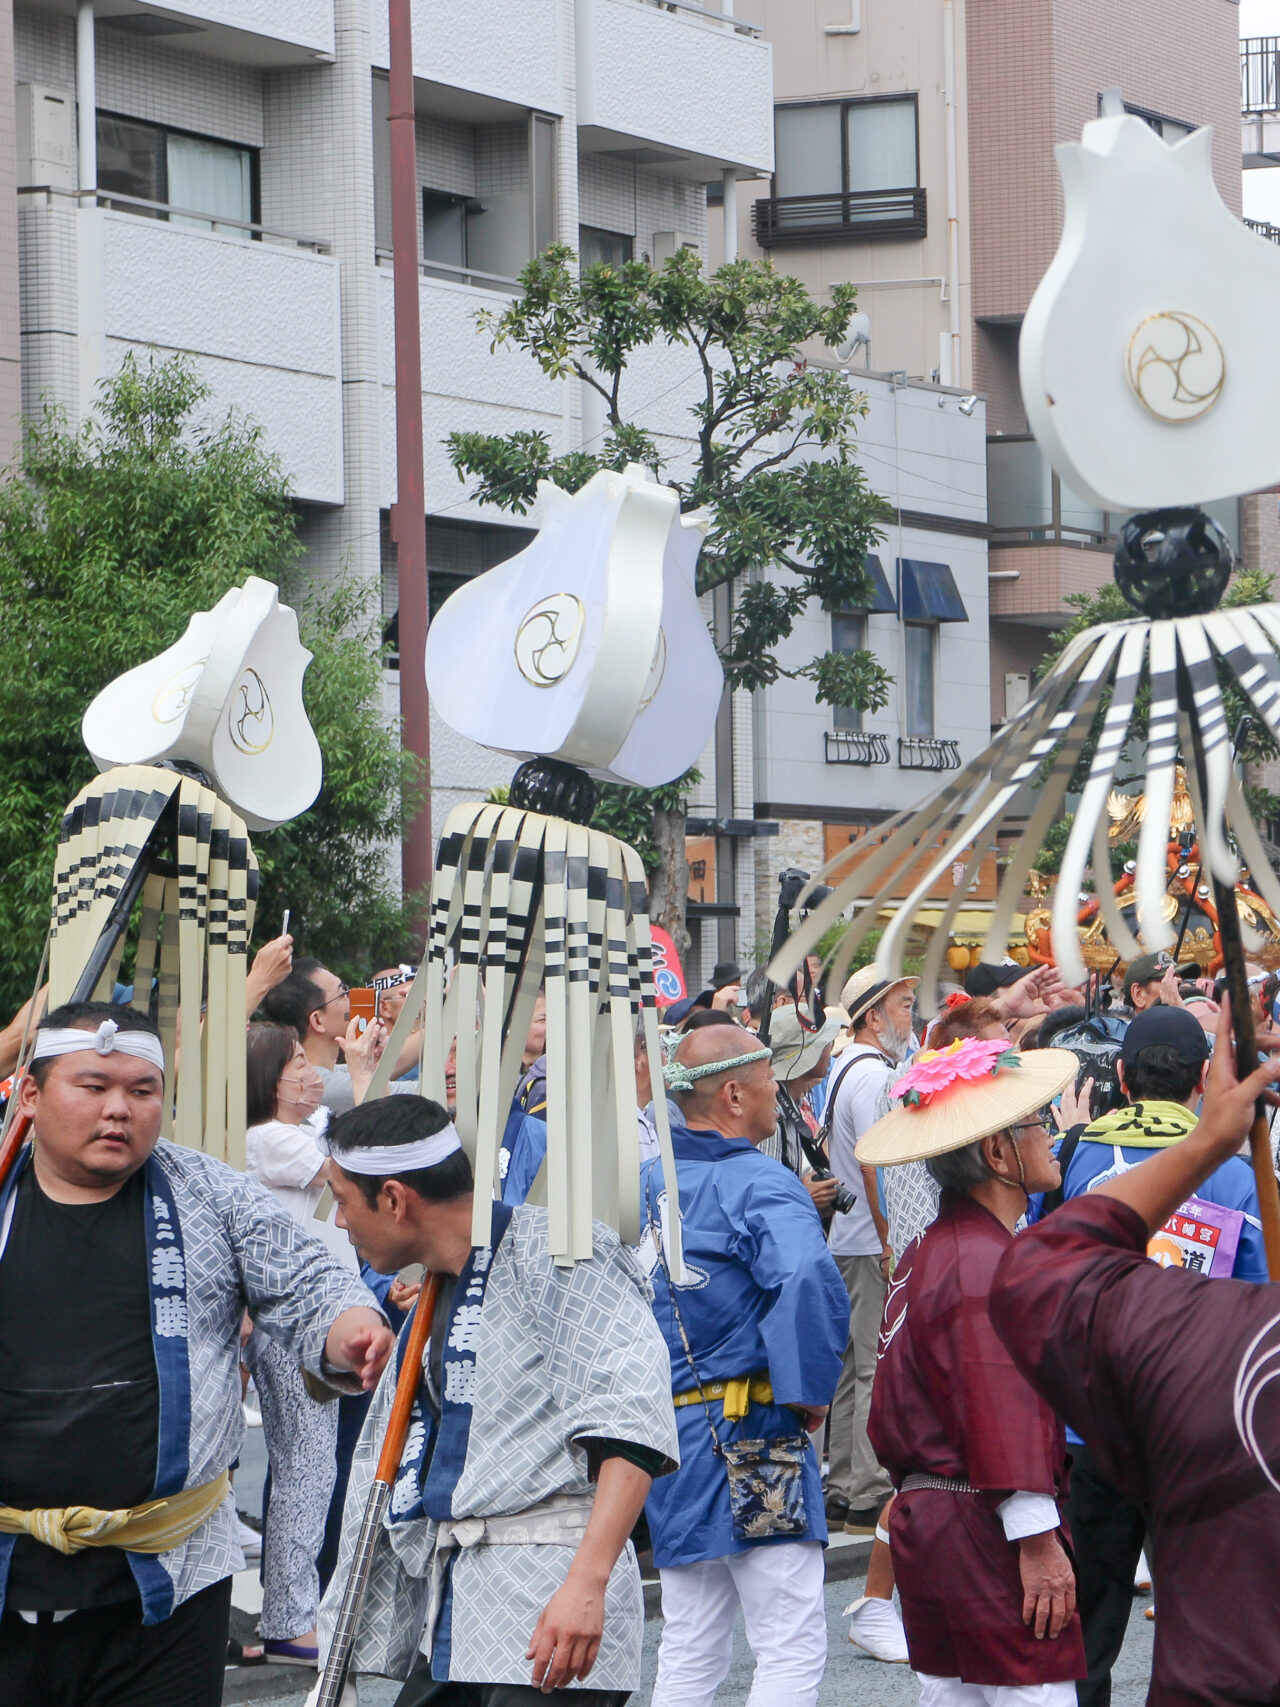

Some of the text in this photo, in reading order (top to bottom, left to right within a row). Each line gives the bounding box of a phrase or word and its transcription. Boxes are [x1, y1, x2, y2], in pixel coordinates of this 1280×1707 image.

[1176, 1202, 1203, 1219] 五年
[1164, 1218, 1214, 1243] 八幡宮
